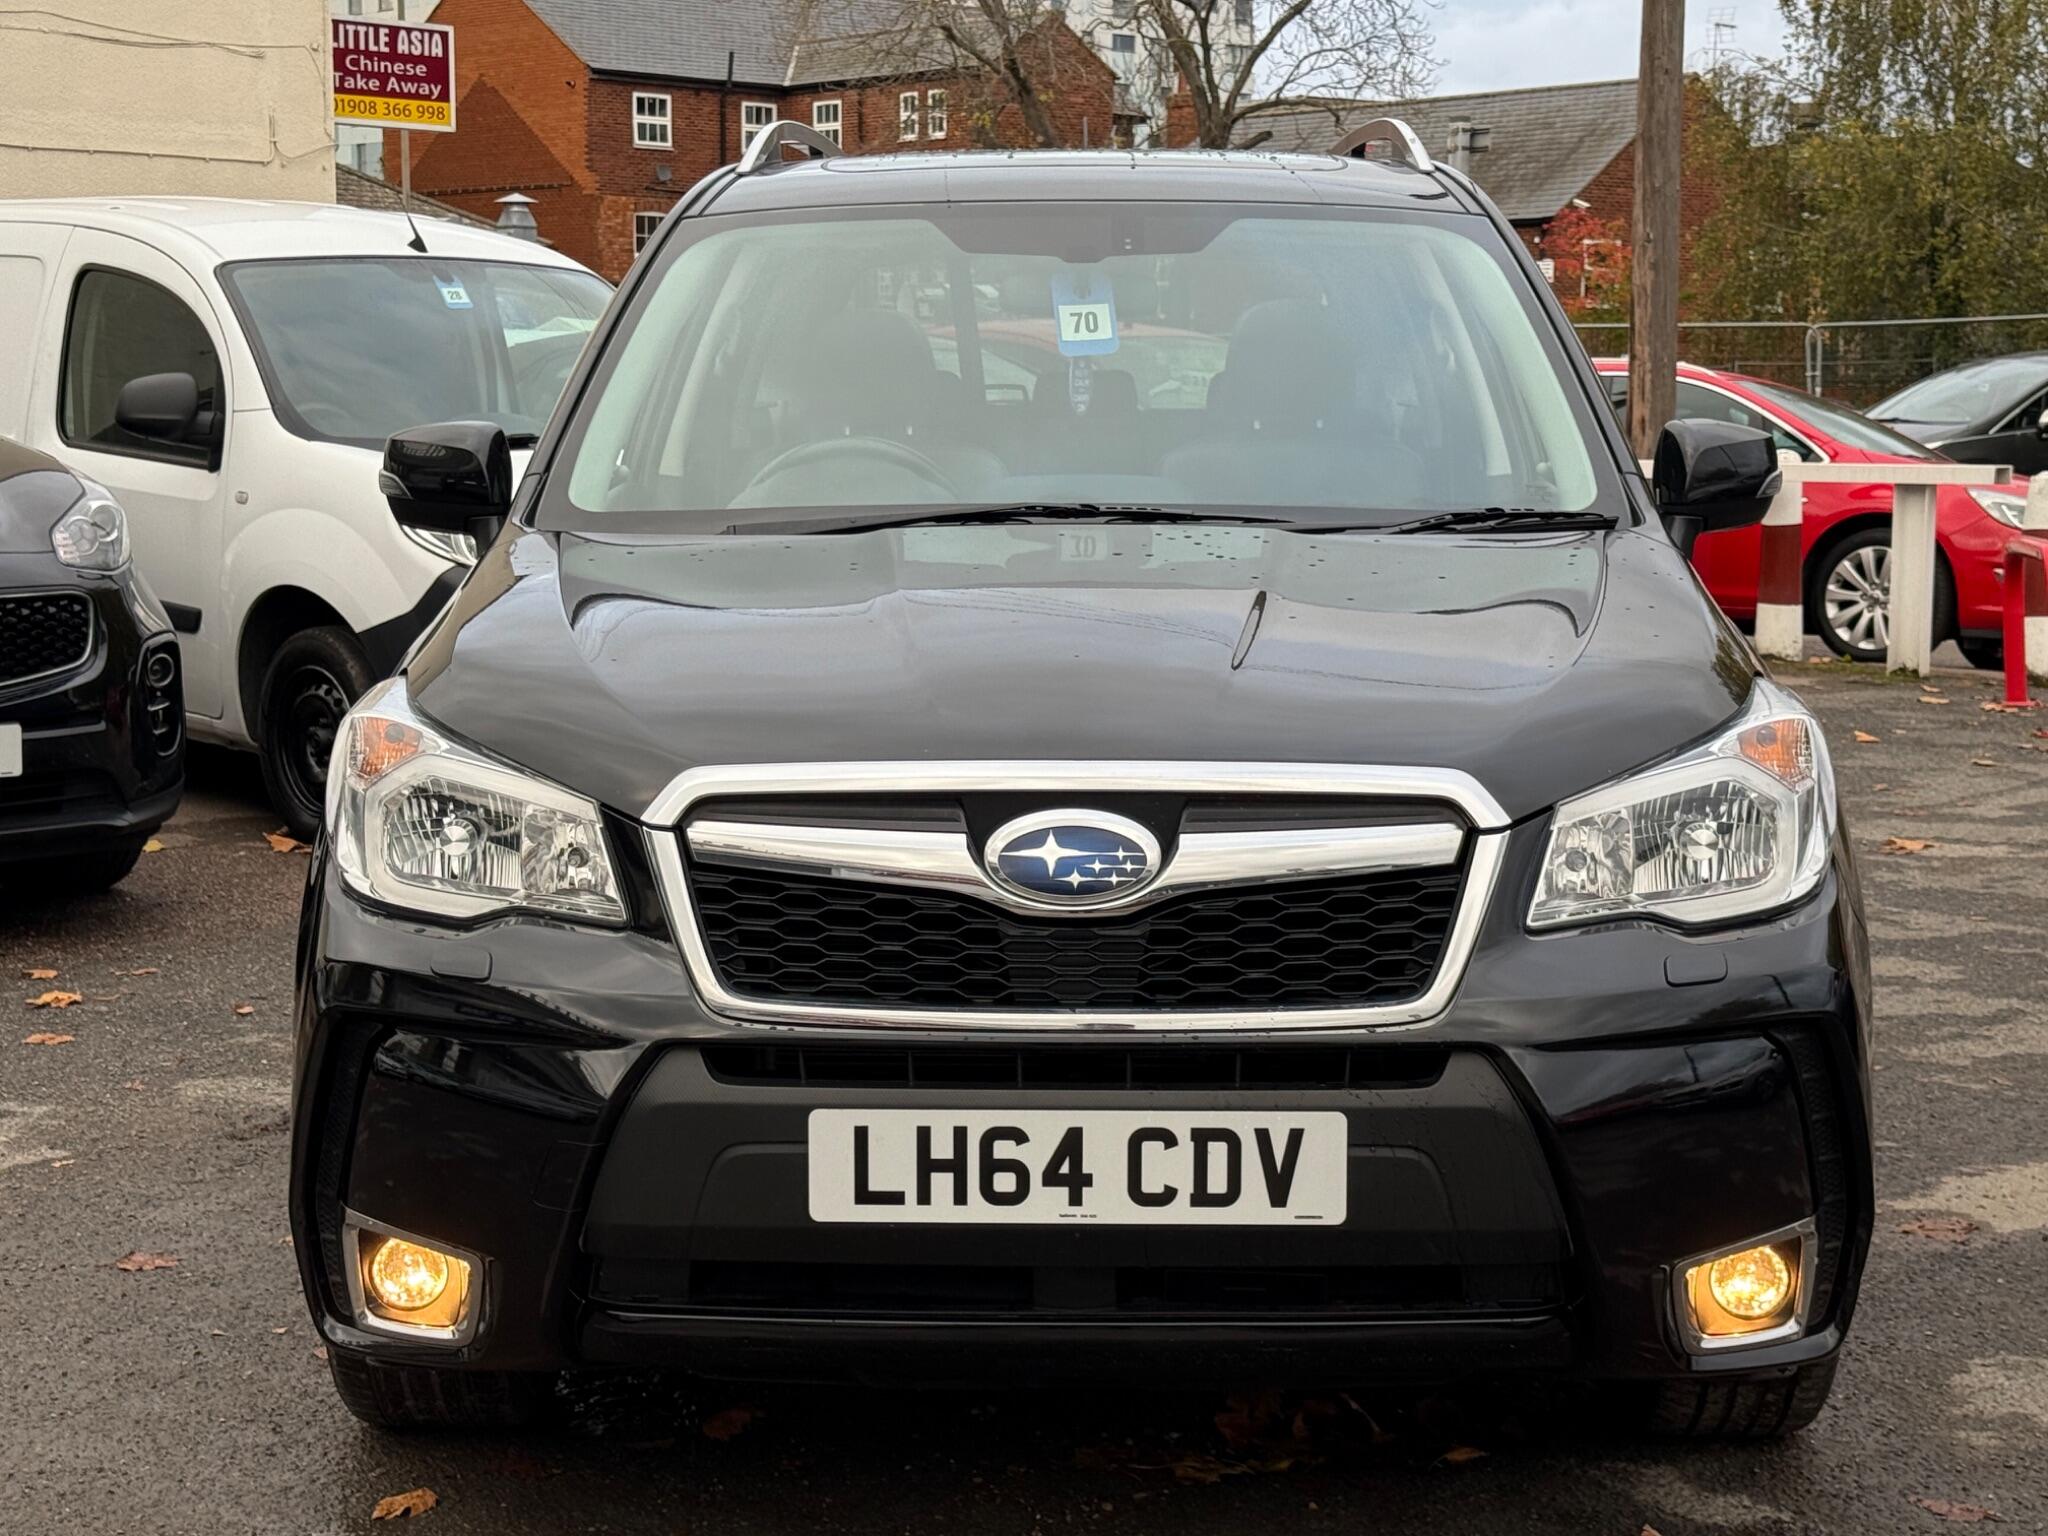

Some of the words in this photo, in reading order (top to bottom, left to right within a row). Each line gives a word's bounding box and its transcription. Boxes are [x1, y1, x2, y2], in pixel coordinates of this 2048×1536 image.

[333, 23, 390, 53] ITTLE
[397, 30, 443, 58] ASIA
[345, 54, 427, 77] Chinese
[334, 72, 380, 91] Take
[386, 76, 442, 100] Away
[382, 101, 412, 118] 366
[416, 105, 446, 120] 998
[1070, 311, 1099, 334] 70
[854, 1126, 1093, 1207] LH64
[1127, 1127, 1305, 1209] CDV
